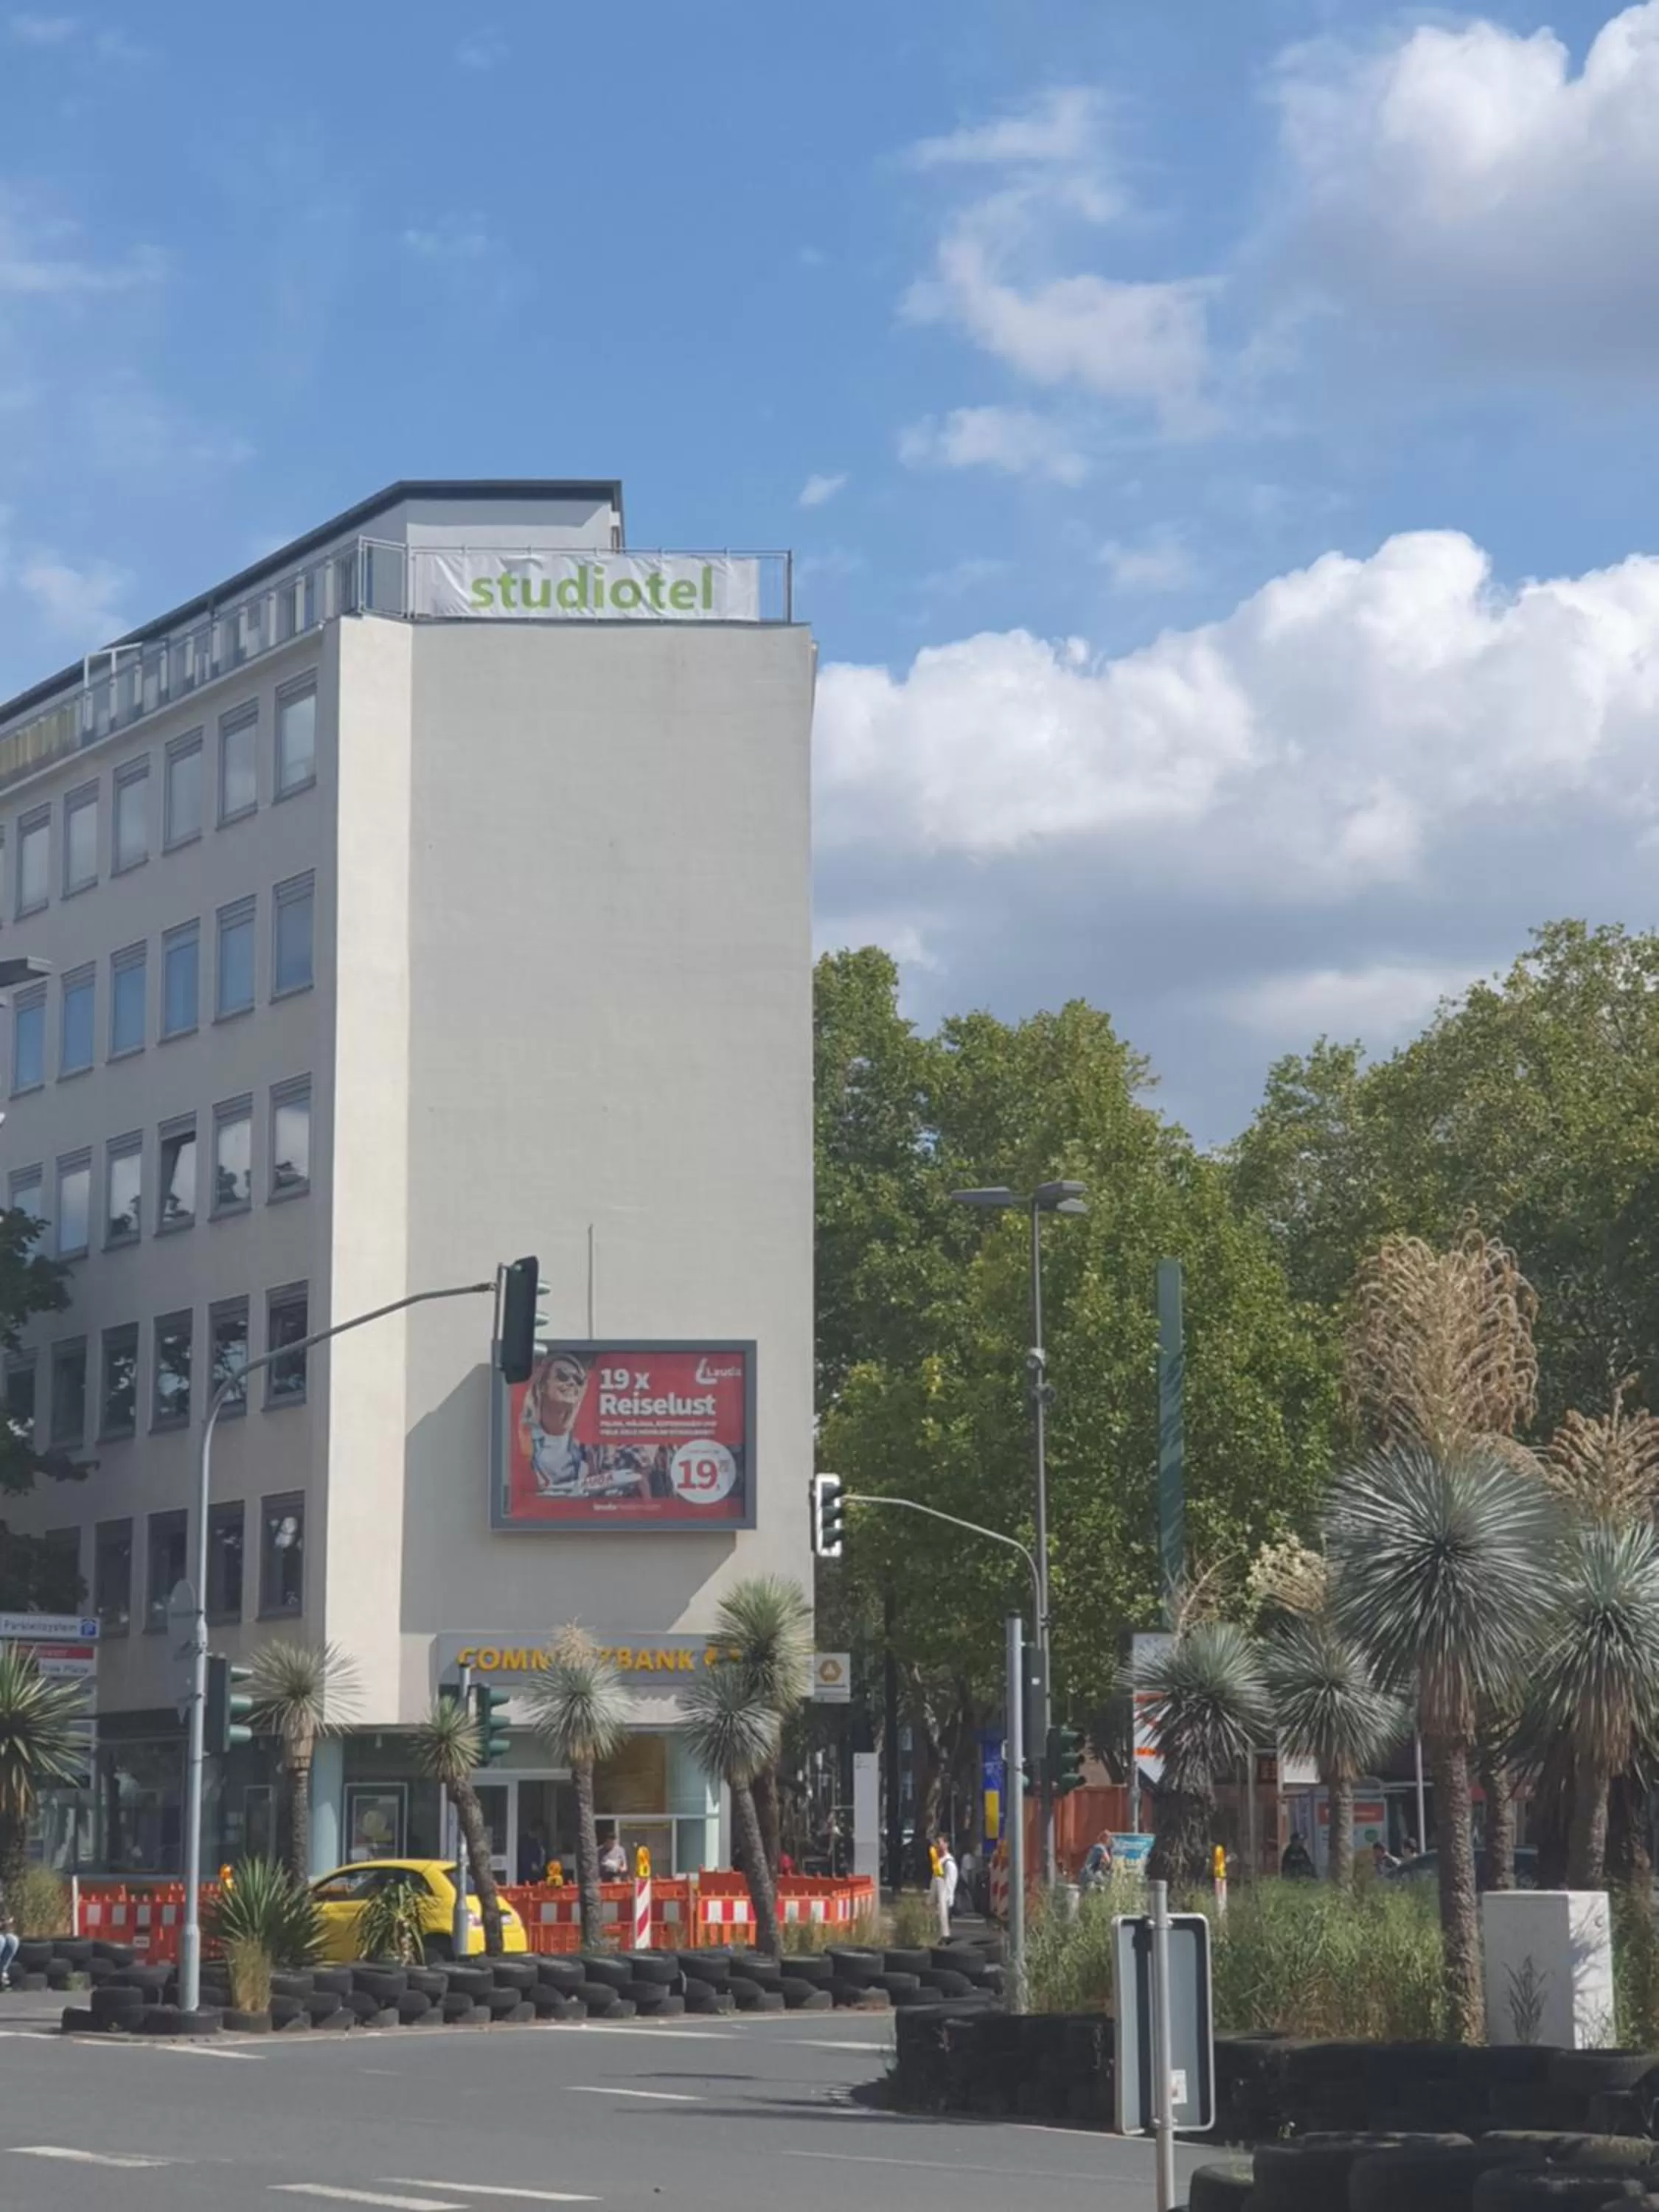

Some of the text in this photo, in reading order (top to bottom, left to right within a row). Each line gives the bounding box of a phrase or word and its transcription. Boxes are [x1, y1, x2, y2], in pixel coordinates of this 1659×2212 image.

[470, 565, 714, 611] studiotel
[599, 1368, 630, 1390] 19
[599, 1391, 717, 1416] Reiselust
